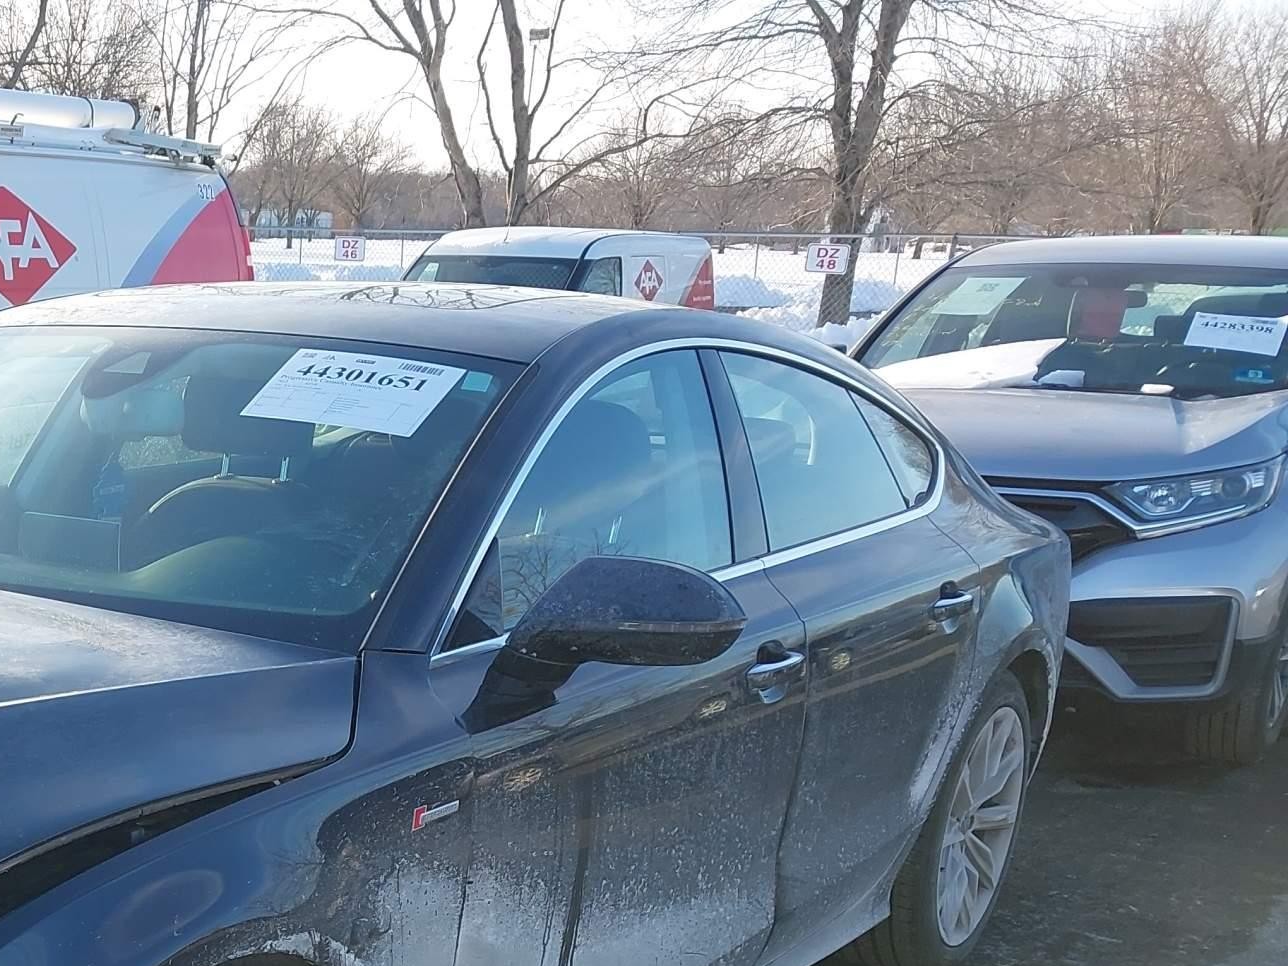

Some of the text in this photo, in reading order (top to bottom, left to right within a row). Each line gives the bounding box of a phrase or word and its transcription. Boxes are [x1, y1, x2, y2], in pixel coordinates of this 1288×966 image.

[197, 183, 215, 200] 322
[342, 239, 359, 249] DZ
[342, 250, 358, 259] 46
[816, 247, 841, 259] DZ
[815, 259, 837, 270] 48
[639, 269, 660, 295] AFA
[1200, 320, 1274, 334] 44283398
[296, 363, 429, 392] 44301651
